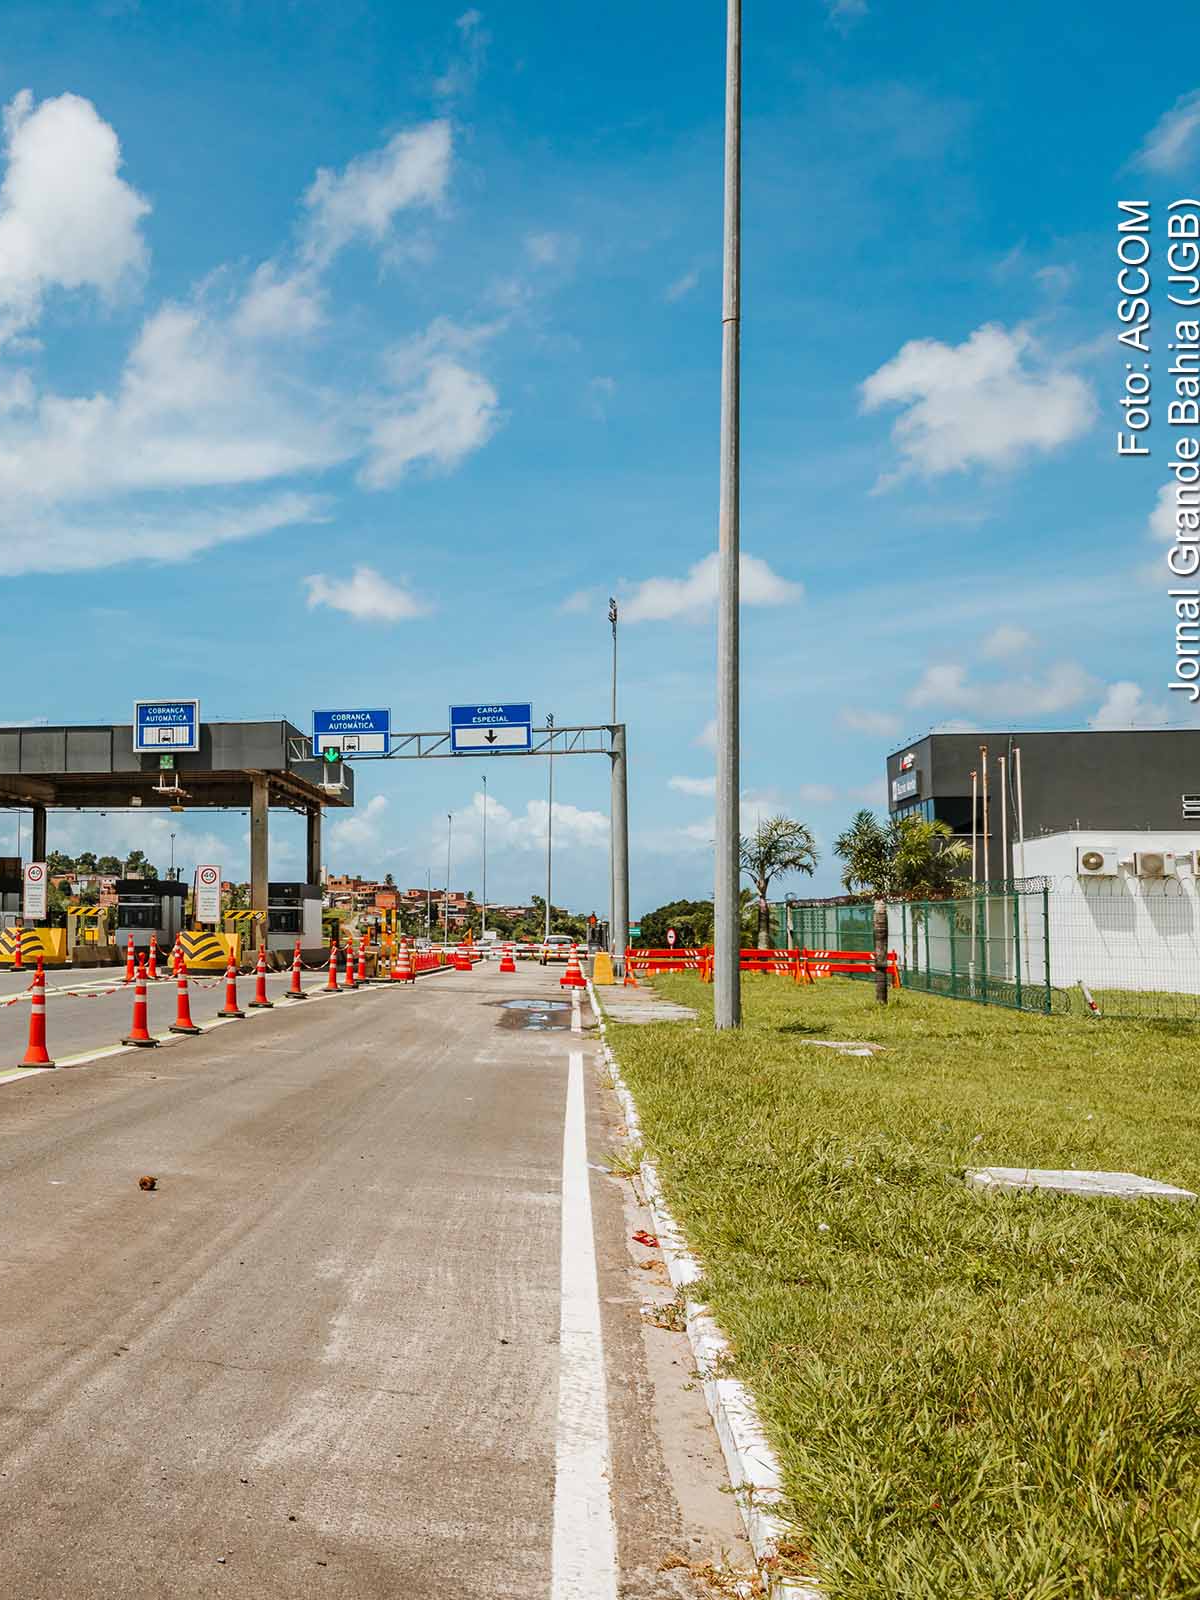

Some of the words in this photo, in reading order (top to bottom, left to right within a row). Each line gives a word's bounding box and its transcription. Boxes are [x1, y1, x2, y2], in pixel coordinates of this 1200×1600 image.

[477, 706, 504, 714] CARGA
[331, 713, 371, 722] COBRANÇA
[328, 721, 374, 730] AUTOMÁTICA
